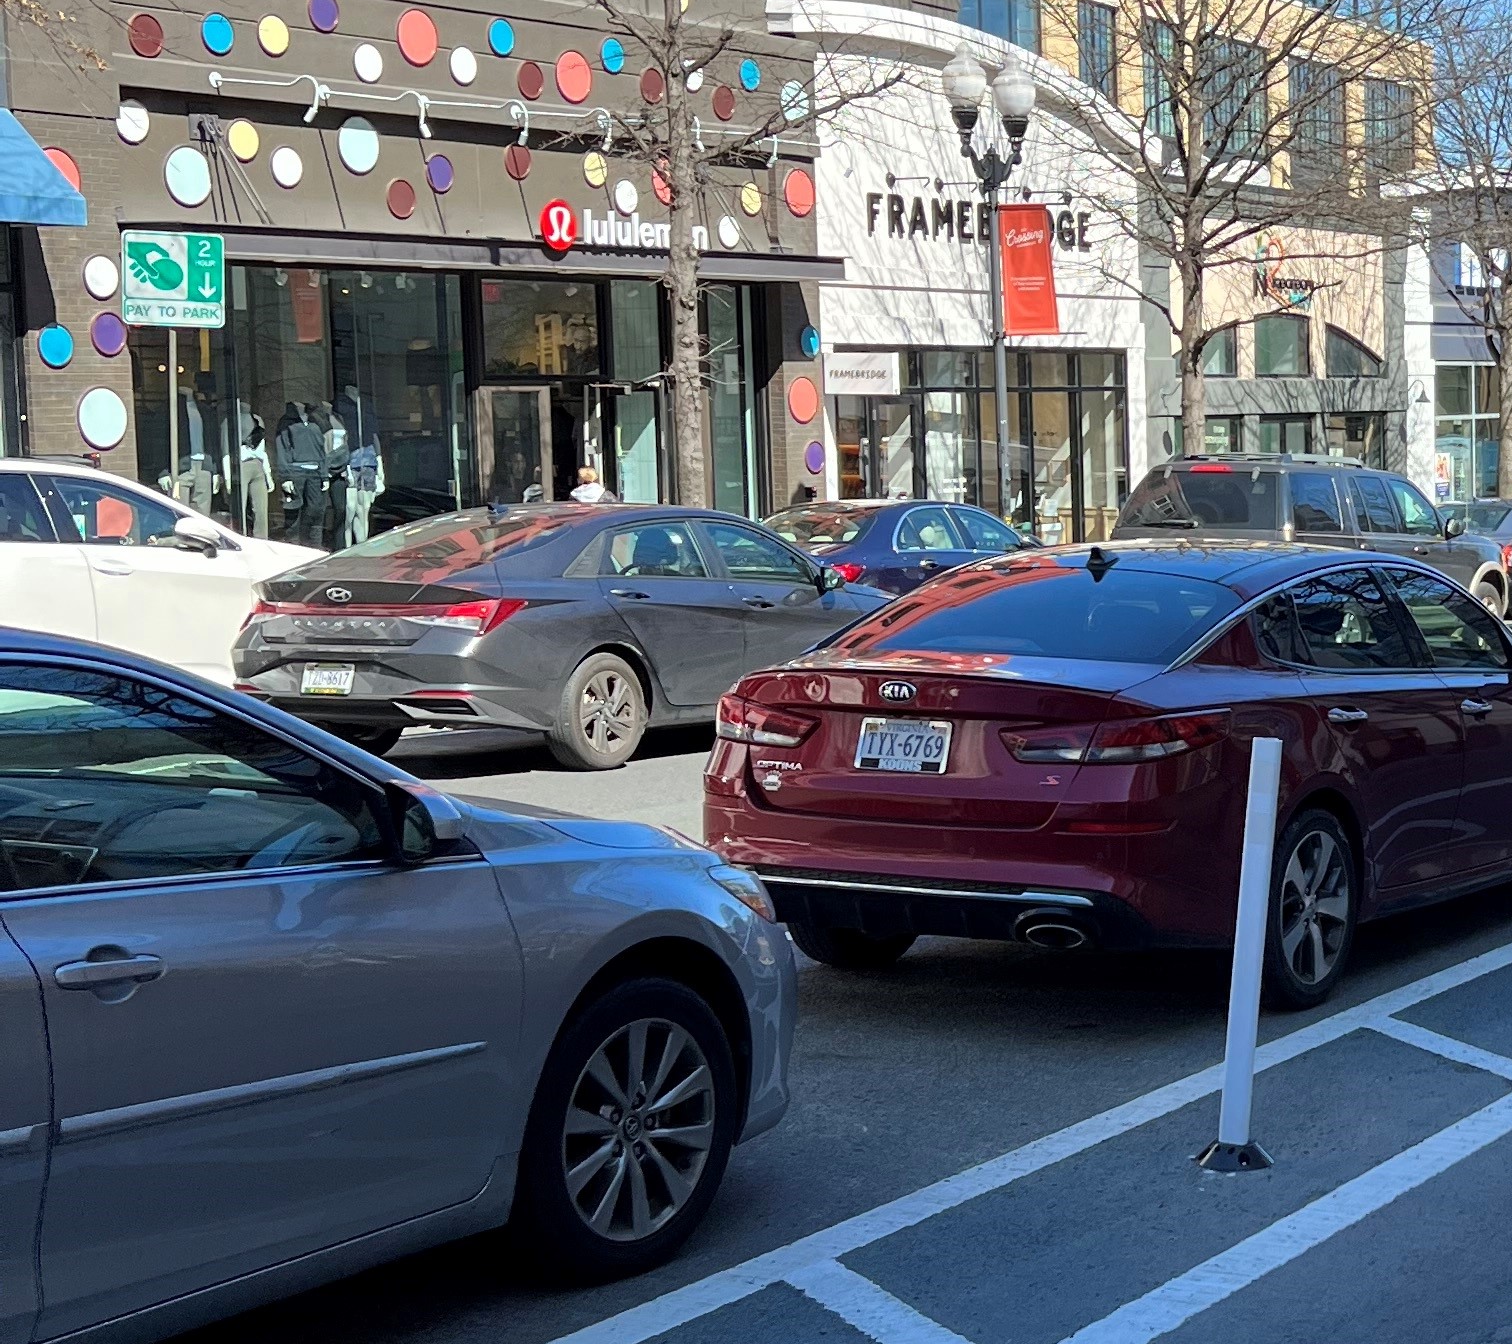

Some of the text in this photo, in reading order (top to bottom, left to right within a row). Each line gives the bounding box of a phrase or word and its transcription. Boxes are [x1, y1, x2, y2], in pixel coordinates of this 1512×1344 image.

[583, 209, 708, 250] lululemn
[866, 193, 1092, 252] FRAMEBGE
[198, 240, 211, 258] 2
[195, 259, 216, 267] HOUR
[126, 304, 219, 320] PAY TO PARK
[884, 685, 910, 698] KIA
[868, 732, 944, 759] TYX-6769
